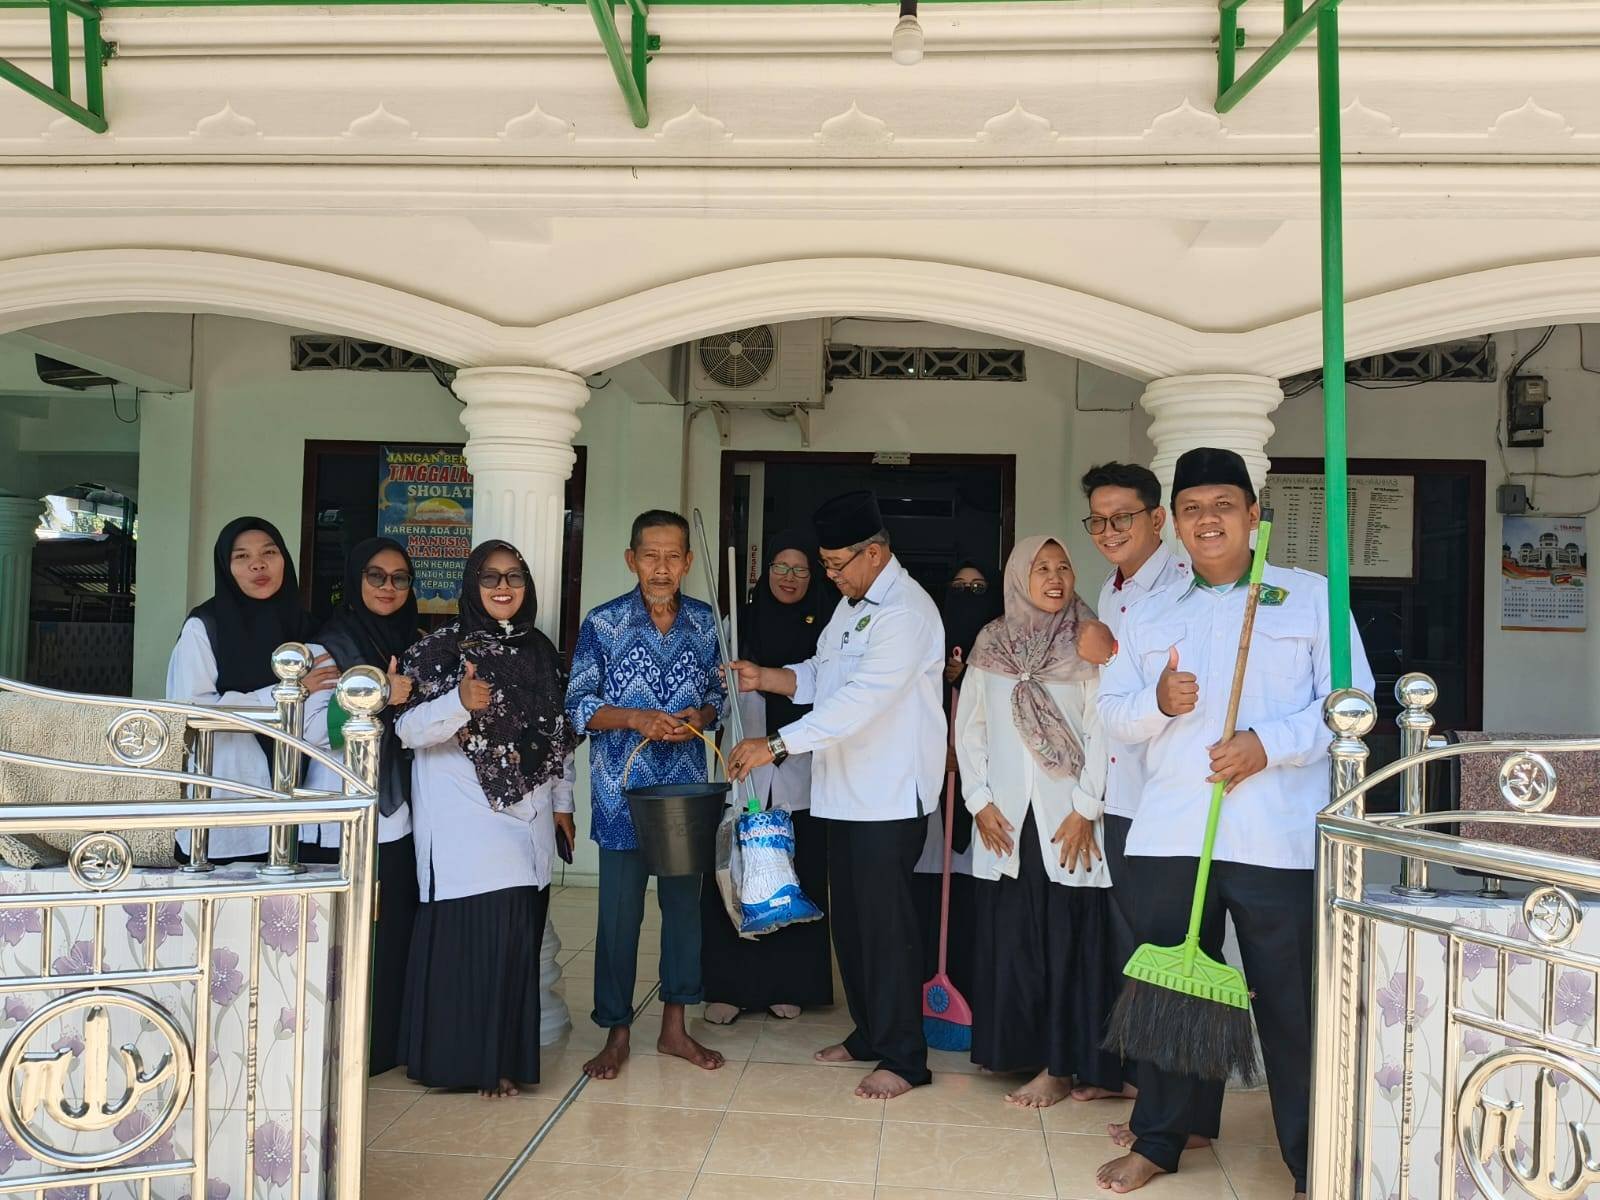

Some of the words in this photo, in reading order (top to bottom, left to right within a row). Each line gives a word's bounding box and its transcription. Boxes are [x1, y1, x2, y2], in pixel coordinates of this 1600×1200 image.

[386, 453, 441, 464] JANGAN
[389, 464, 473, 483] TINGGALK
[407, 485, 473, 498] SHOLAT
[384, 525, 427, 534] KARENA
[430, 526, 450, 535] ADA
[408, 534, 470, 547] MANUSIA
[421, 580, 455, 589] KEPADA
